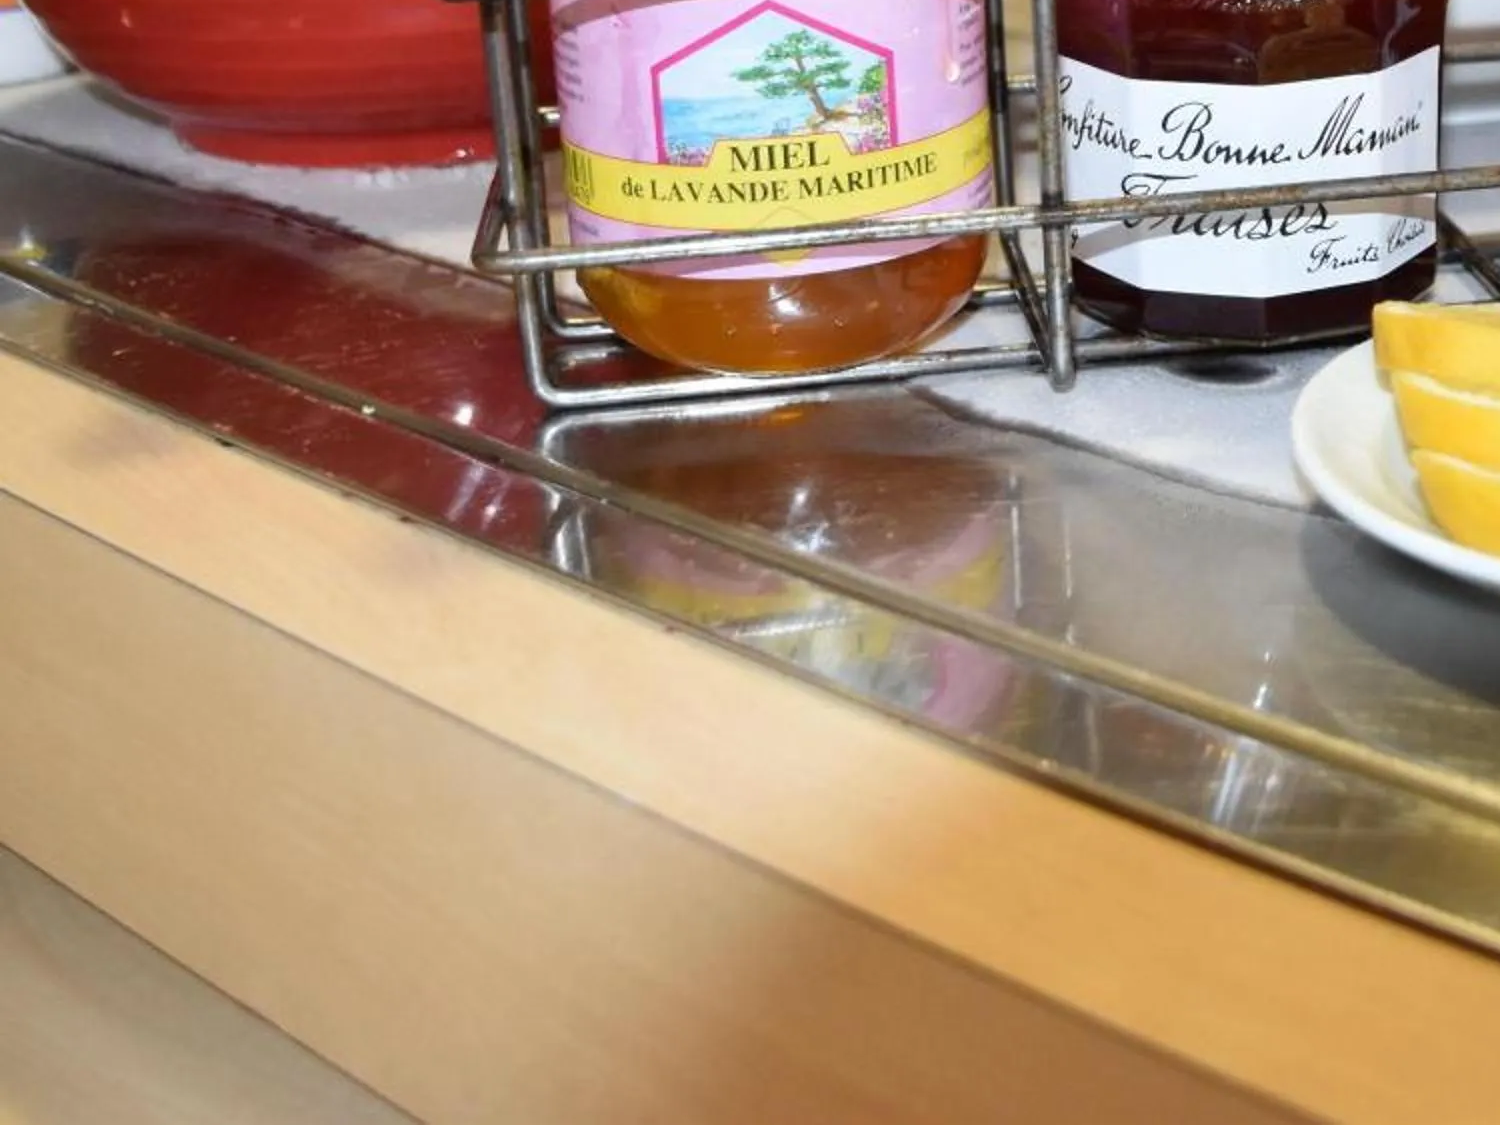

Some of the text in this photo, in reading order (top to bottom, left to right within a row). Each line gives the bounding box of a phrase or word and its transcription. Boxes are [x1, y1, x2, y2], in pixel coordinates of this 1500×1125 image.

[1157, 102, 1291, 165] Bonne
[621, 176, 645, 200] de
[650, 176, 792, 203] LAVANDE
[798, 152, 937, 200] MARITIME
[730, 141, 830, 173] MIEL
[1307, 235, 1380, 273] Fruits
